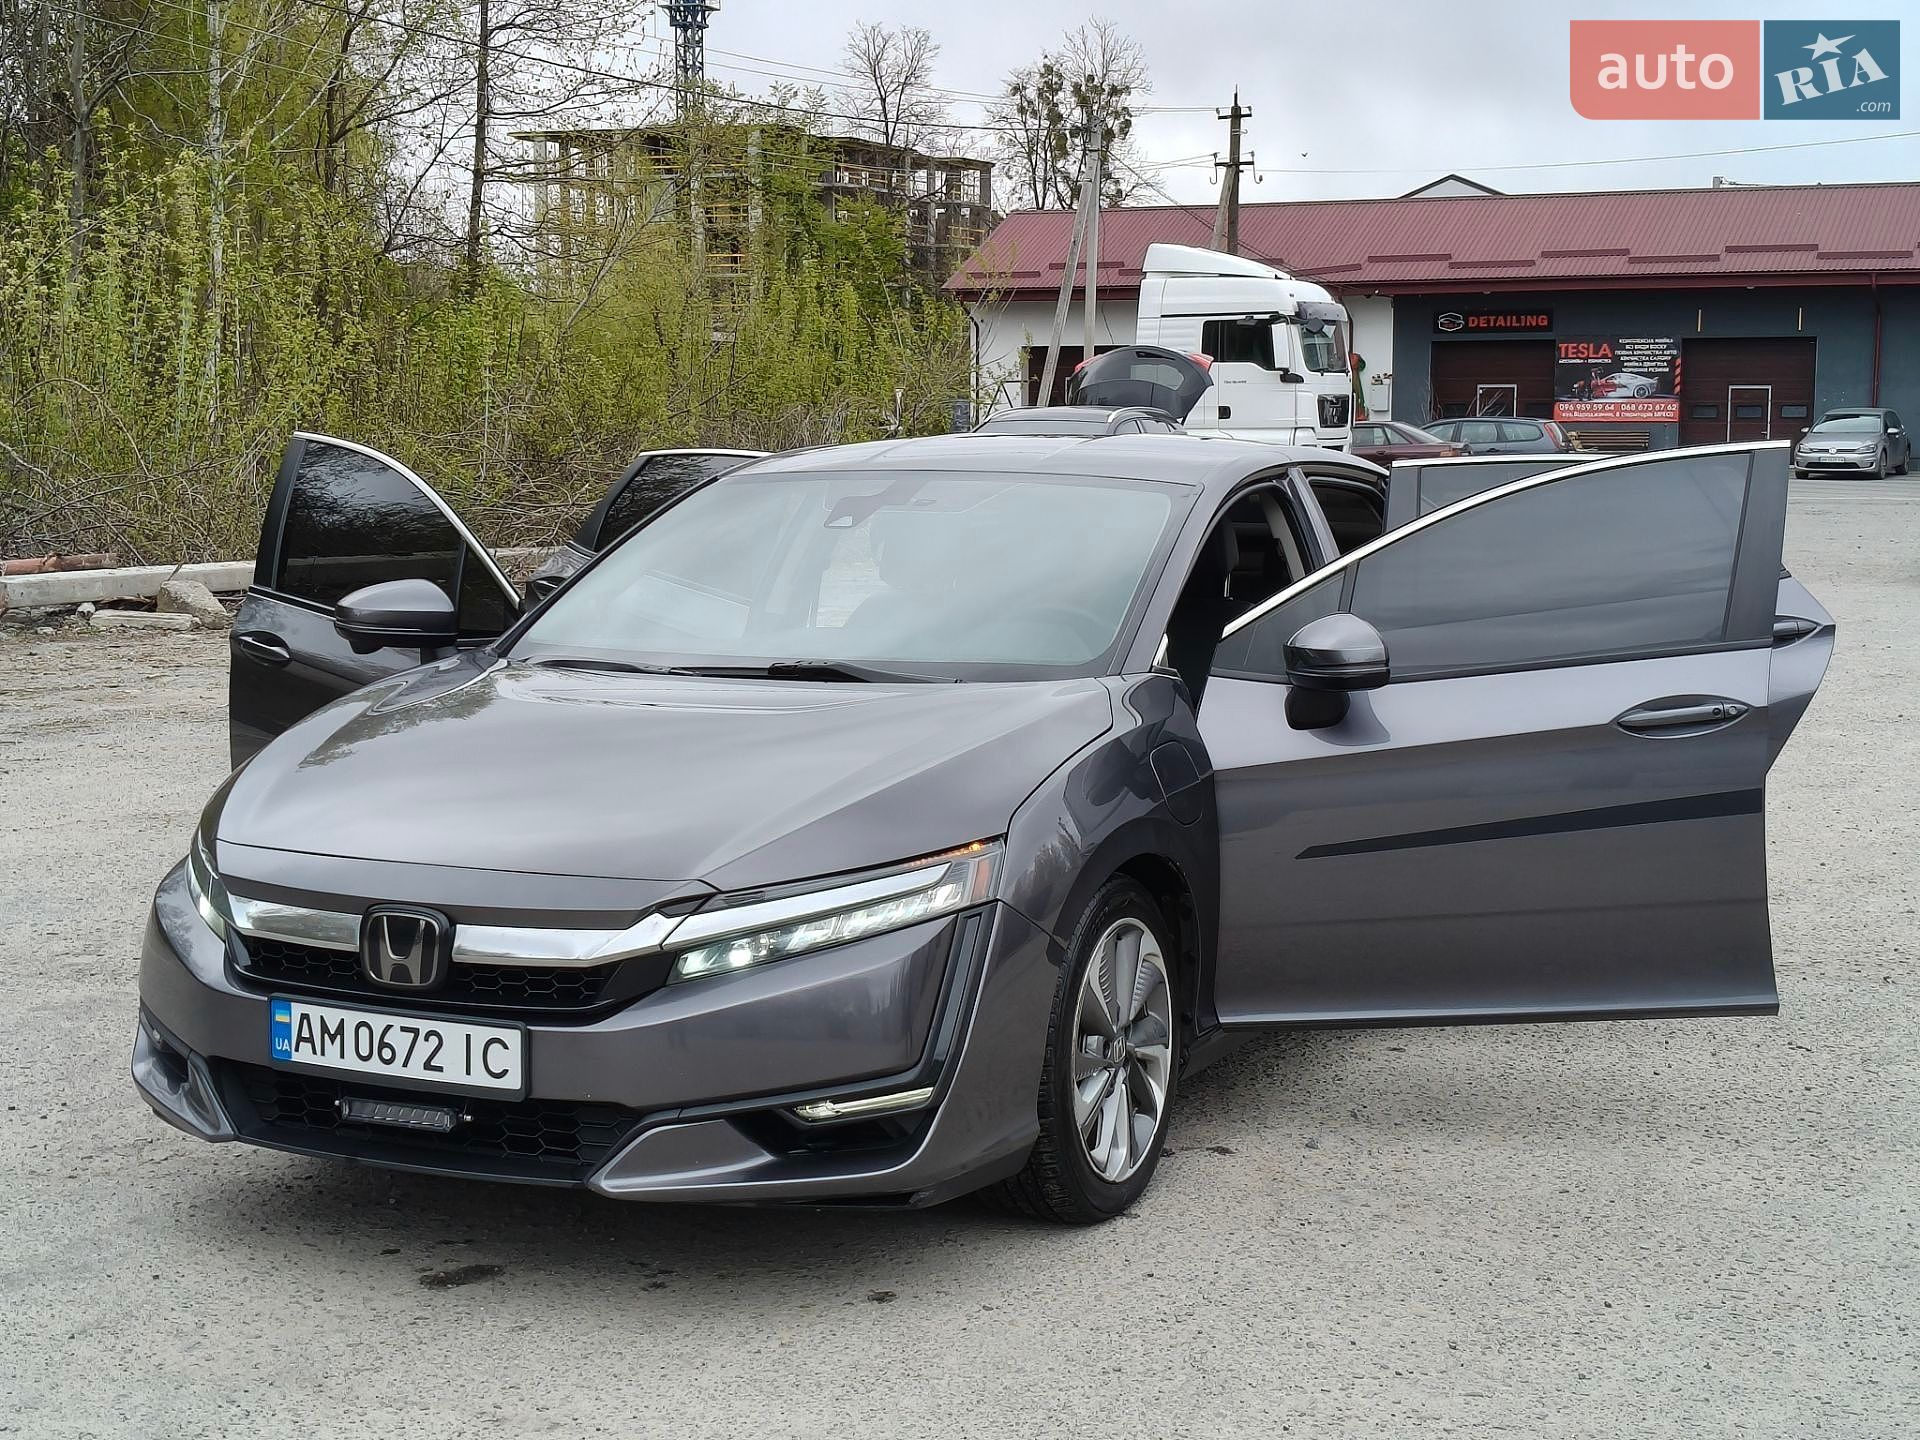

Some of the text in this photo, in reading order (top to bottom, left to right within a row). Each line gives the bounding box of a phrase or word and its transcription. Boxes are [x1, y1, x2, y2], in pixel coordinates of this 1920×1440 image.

[1468, 315, 1548, 328] DETAILING
[1558, 343, 1612, 358] TESLA
[1559, 403, 1615, 411] 096 959 59 64
[1621, 403, 1677, 411] 068 673 67 62
[275, 1038, 291, 1052] UA
[354, 1020, 444, 1073] 0672
[465, 1033, 510, 1080] IC
